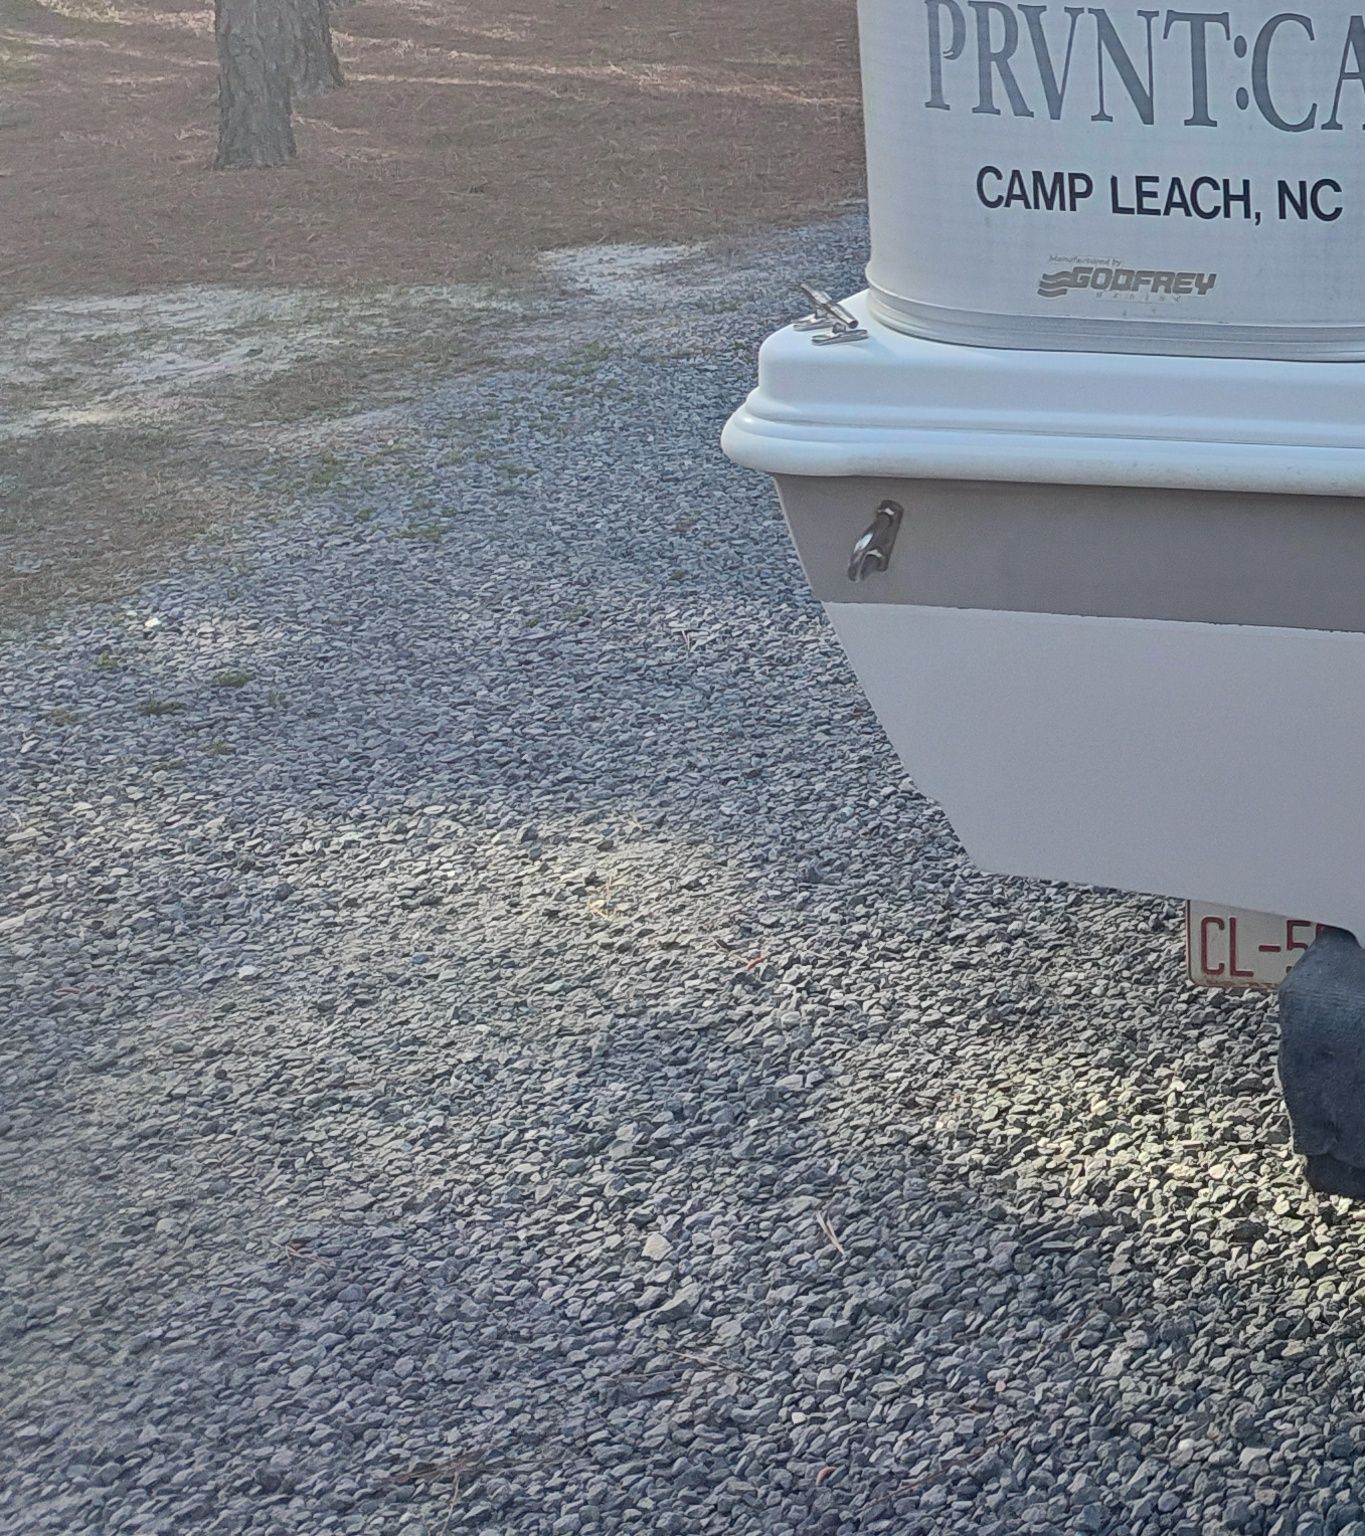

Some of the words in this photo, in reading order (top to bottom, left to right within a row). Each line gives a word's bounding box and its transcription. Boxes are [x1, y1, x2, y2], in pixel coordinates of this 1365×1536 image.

[975, 165, 1094, 213] CAMP
[1109, 175, 1262, 226] LEACH,
[1277, 178, 1344, 223] NC
[1071, 266, 1217, 296] GODFREY
[1200, 916, 1326, 978] CL-5
